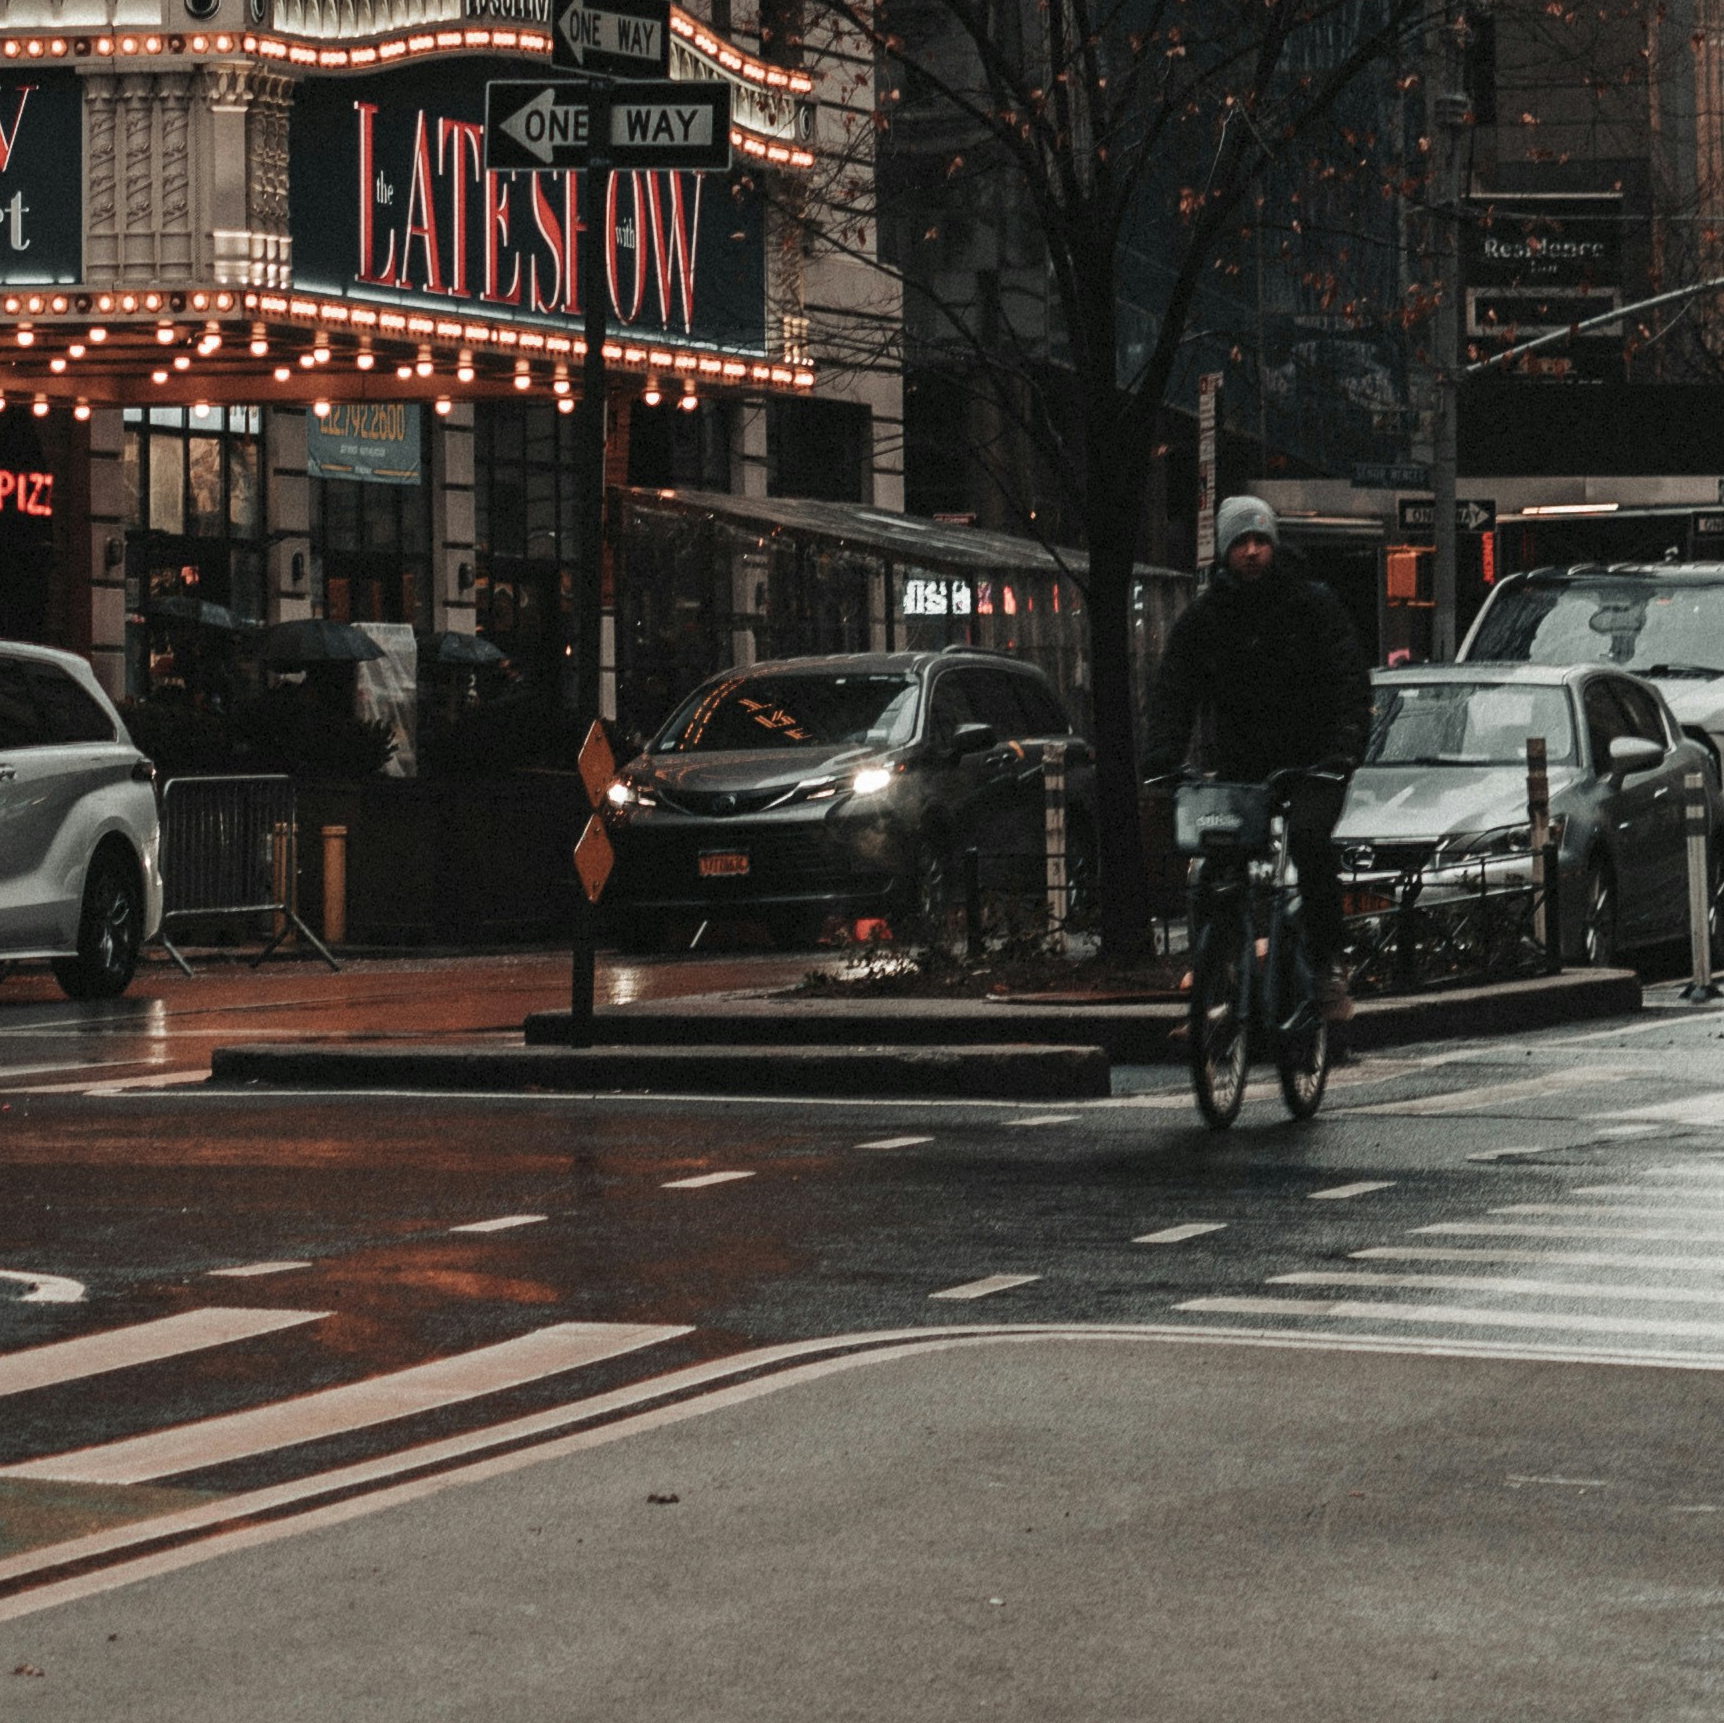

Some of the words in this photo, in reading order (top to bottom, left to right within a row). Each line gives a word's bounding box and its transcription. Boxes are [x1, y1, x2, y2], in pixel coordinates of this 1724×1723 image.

[569, 9, 602, 47] ONE
[617, 17, 655, 55] WAY
[525, 109, 588, 142] ONE
[626, 109, 699, 142] WAY
[354, 101, 522, 306] LATE
[375, 169, 394, 206] the
[613, 217, 636, 251] with
